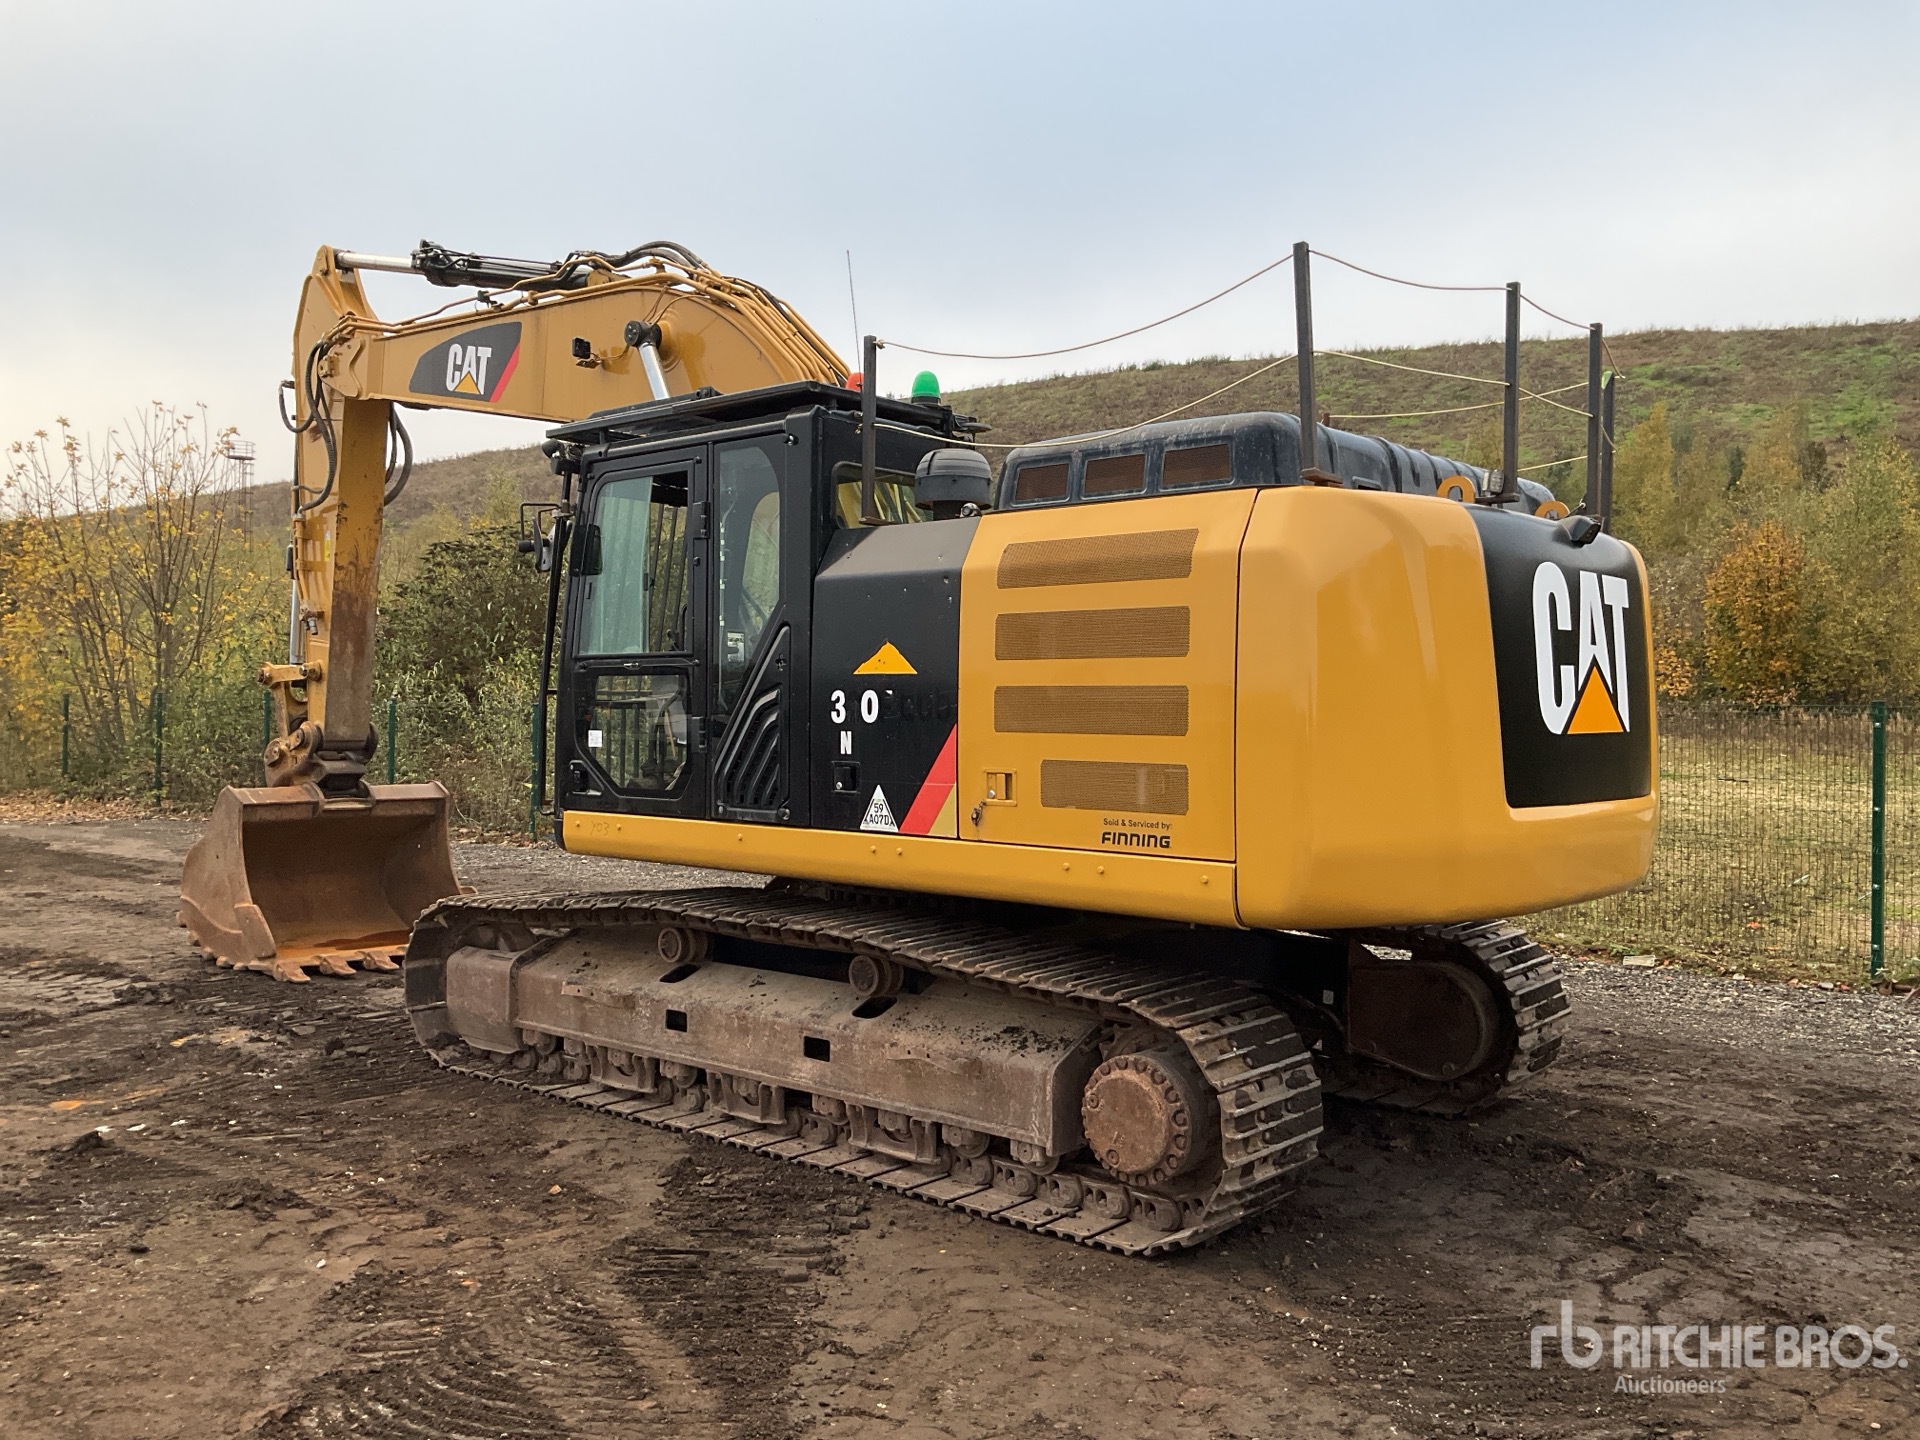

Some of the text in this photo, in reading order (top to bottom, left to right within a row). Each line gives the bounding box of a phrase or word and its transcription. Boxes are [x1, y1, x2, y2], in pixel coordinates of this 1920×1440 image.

[446, 343, 492, 395] CAT
[1532, 561, 1630, 735] CAT
[840, 731, 852, 755] N
[873, 802, 884, 814] 59
[1103, 817, 1119, 827] Sold
[1120, 819, 1127, 827] &
[1128, 819, 1159, 829] Serviced
[1101, 831, 1171, 849] FINNING
